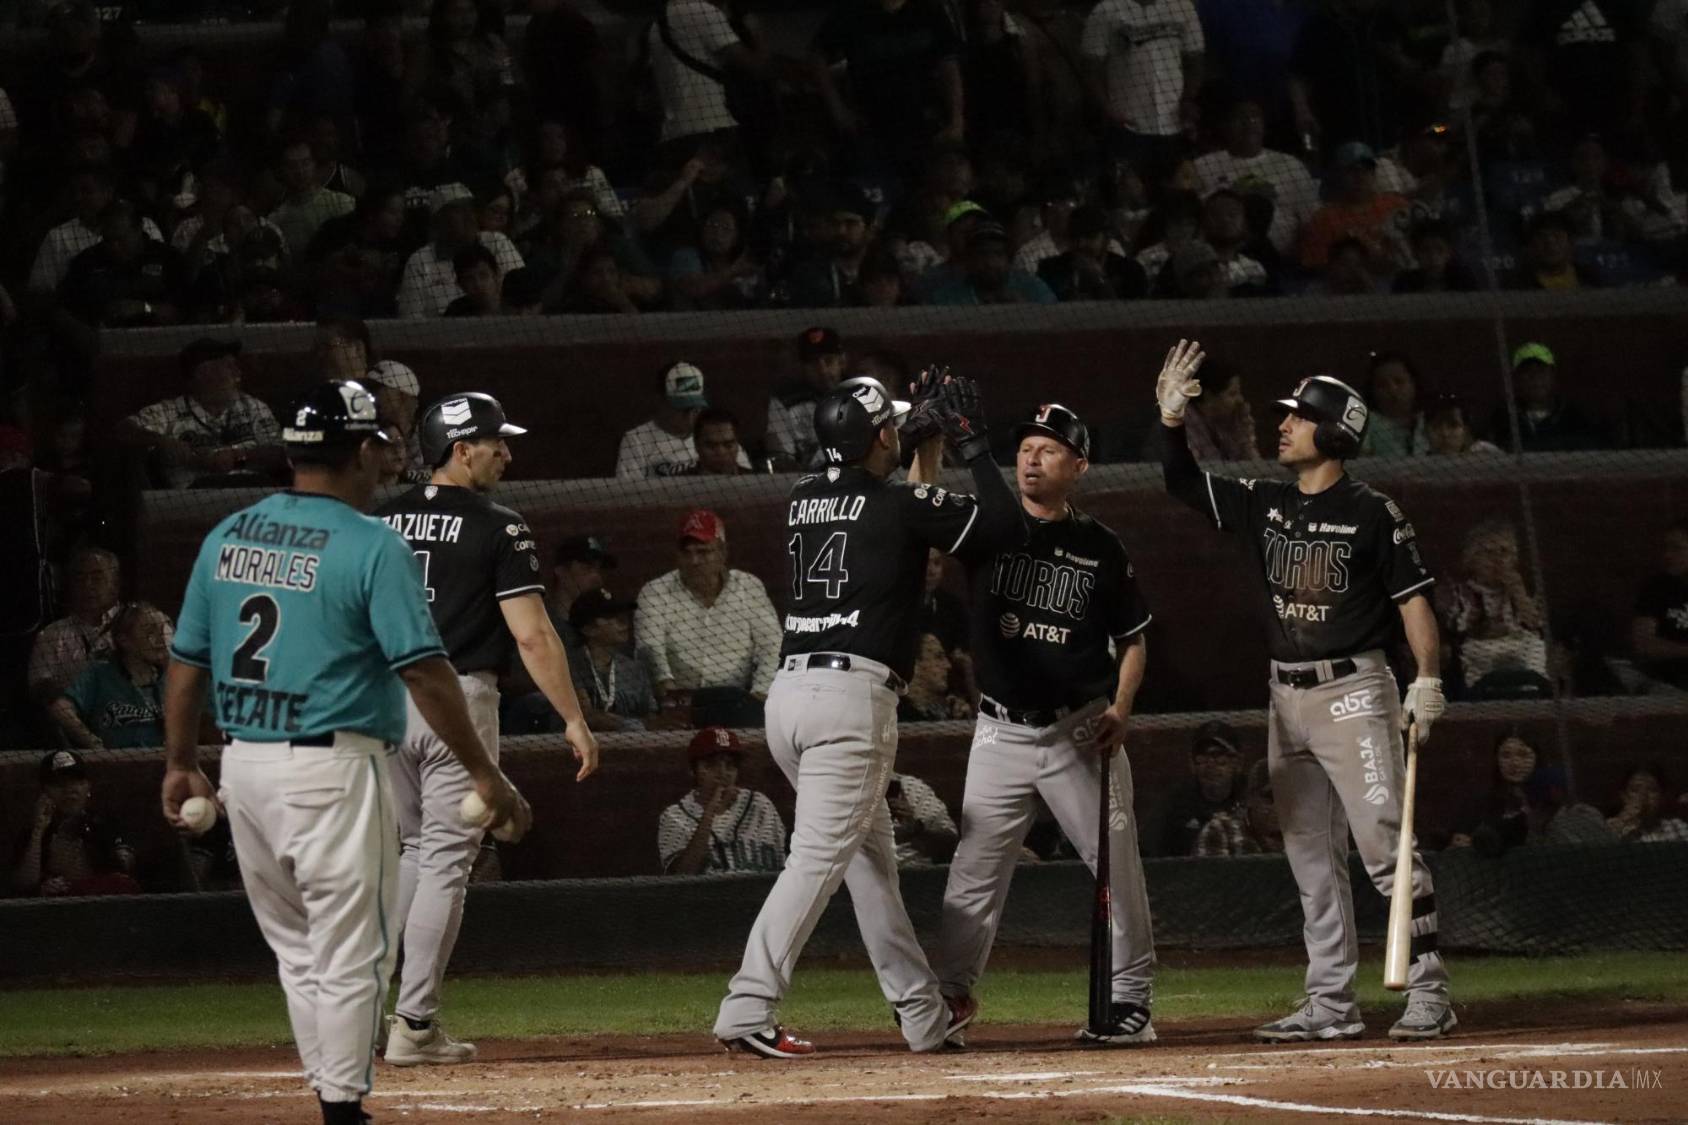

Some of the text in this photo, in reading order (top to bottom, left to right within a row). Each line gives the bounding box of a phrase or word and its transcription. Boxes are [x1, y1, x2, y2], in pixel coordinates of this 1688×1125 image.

[826, 448, 843, 462] 14
[224, 513, 330, 551] Alianza
[788, 495, 866, 527] CARRILLO
[214, 545, 320, 592] MORALES
[788, 531, 848, 600] 14
[1263, 527, 1352, 593] TOROS
[990, 552, 1096, 622] TOROS
[1022, 621, 1071, 645] AT&T
[1285, 604, 1330, 622] AT&T
[231, 592, 281, 684] 2
[1330, 689, 1373, 716] abc
[1360, 737, 1379, 783] BAJA
